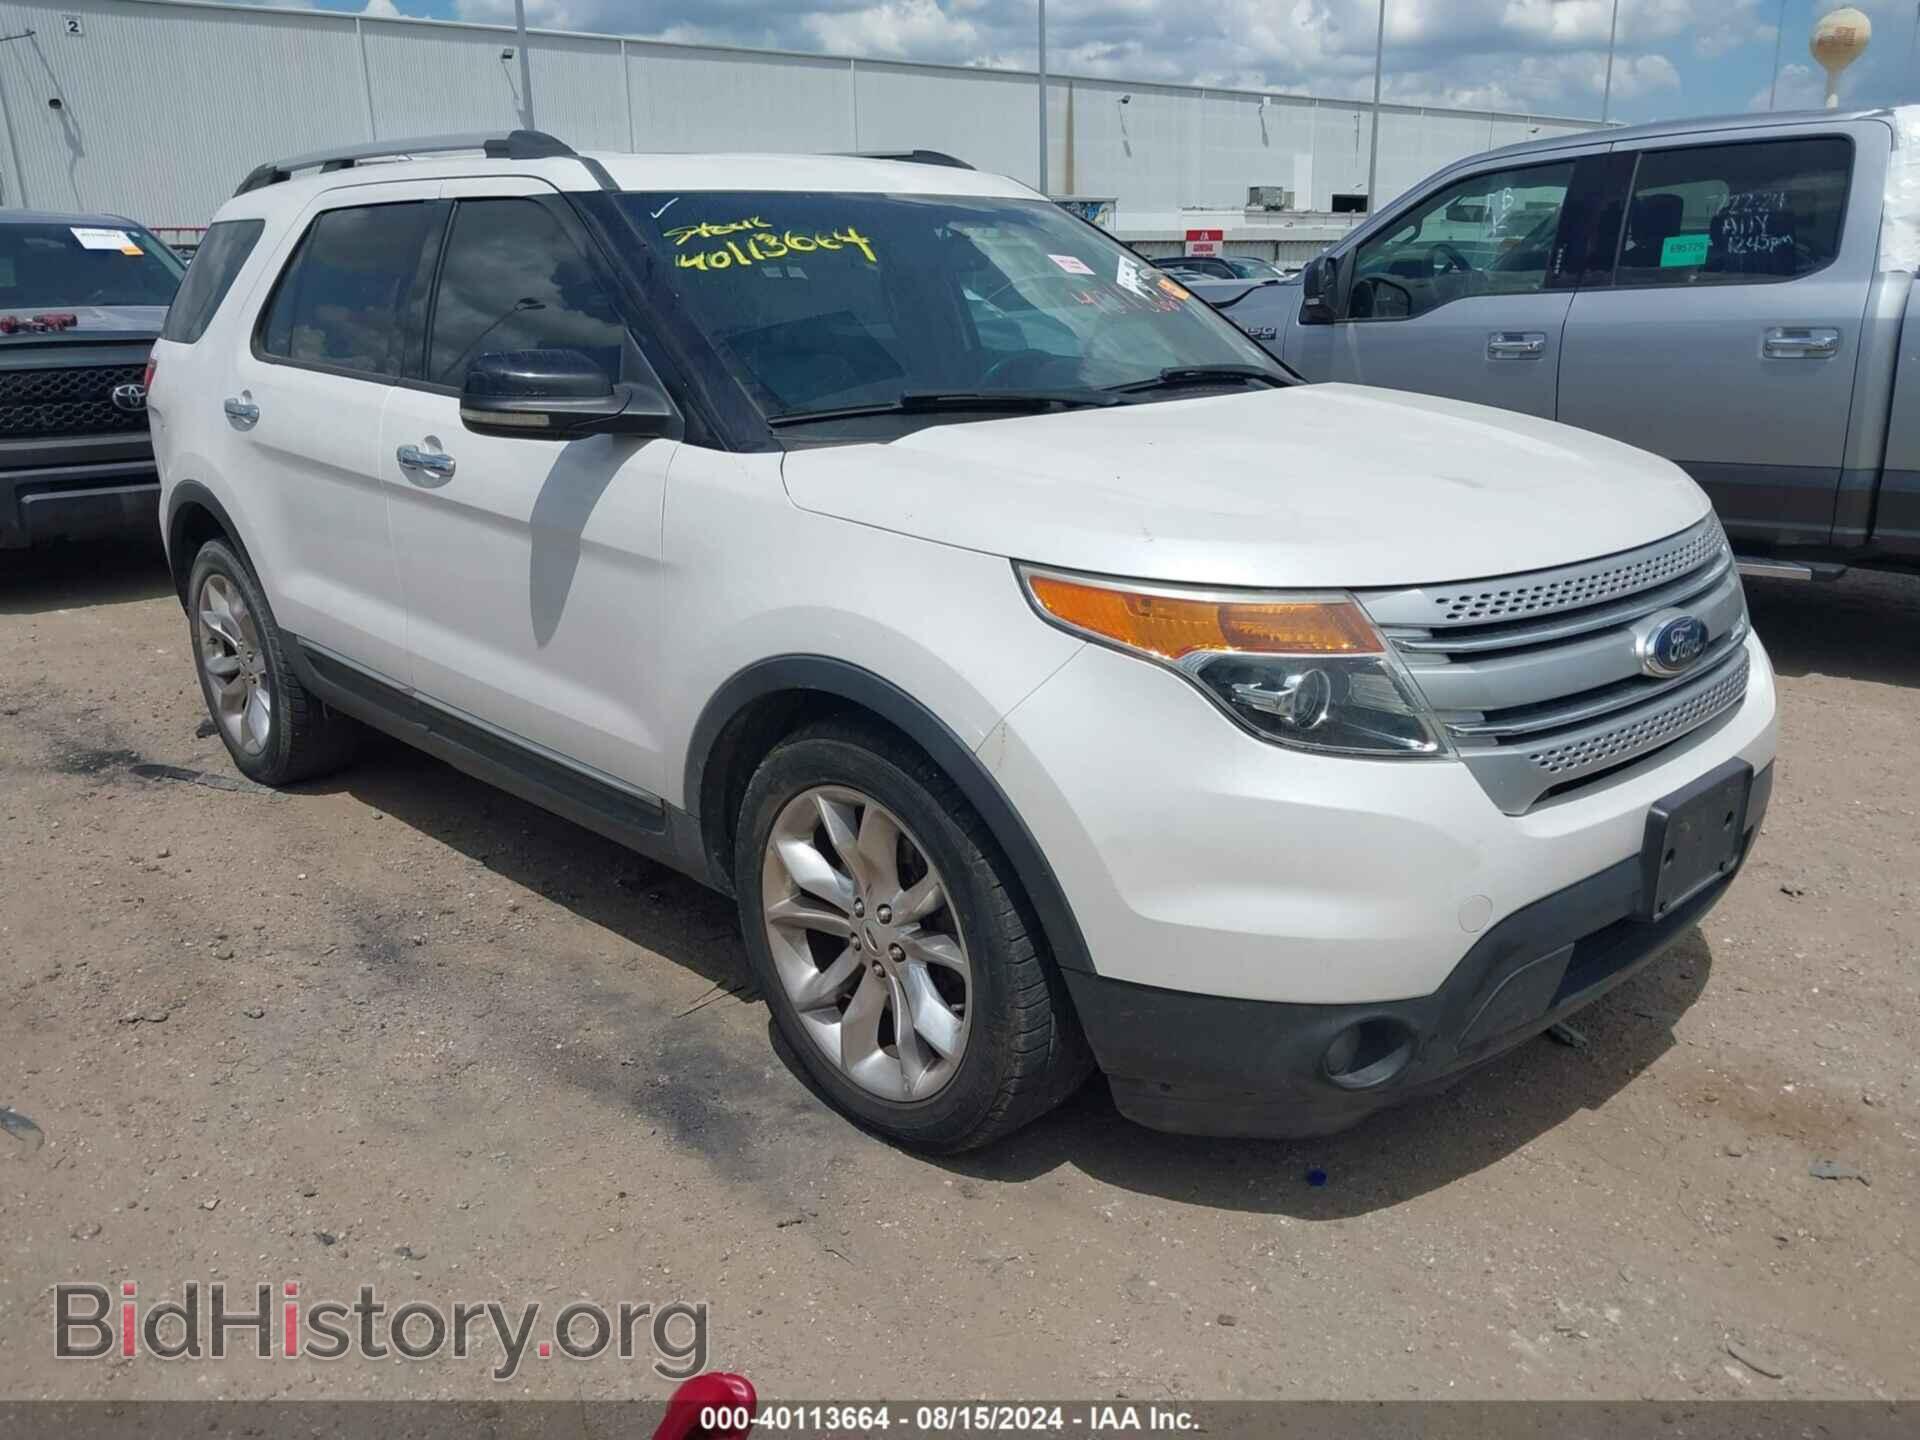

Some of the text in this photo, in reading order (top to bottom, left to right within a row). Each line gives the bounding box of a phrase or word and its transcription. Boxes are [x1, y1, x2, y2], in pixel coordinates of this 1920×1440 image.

[68, 20, 80, 33] 2
[675, 226, 878, 271] 40113664
[1669, 623, 1703, 663] Ford
